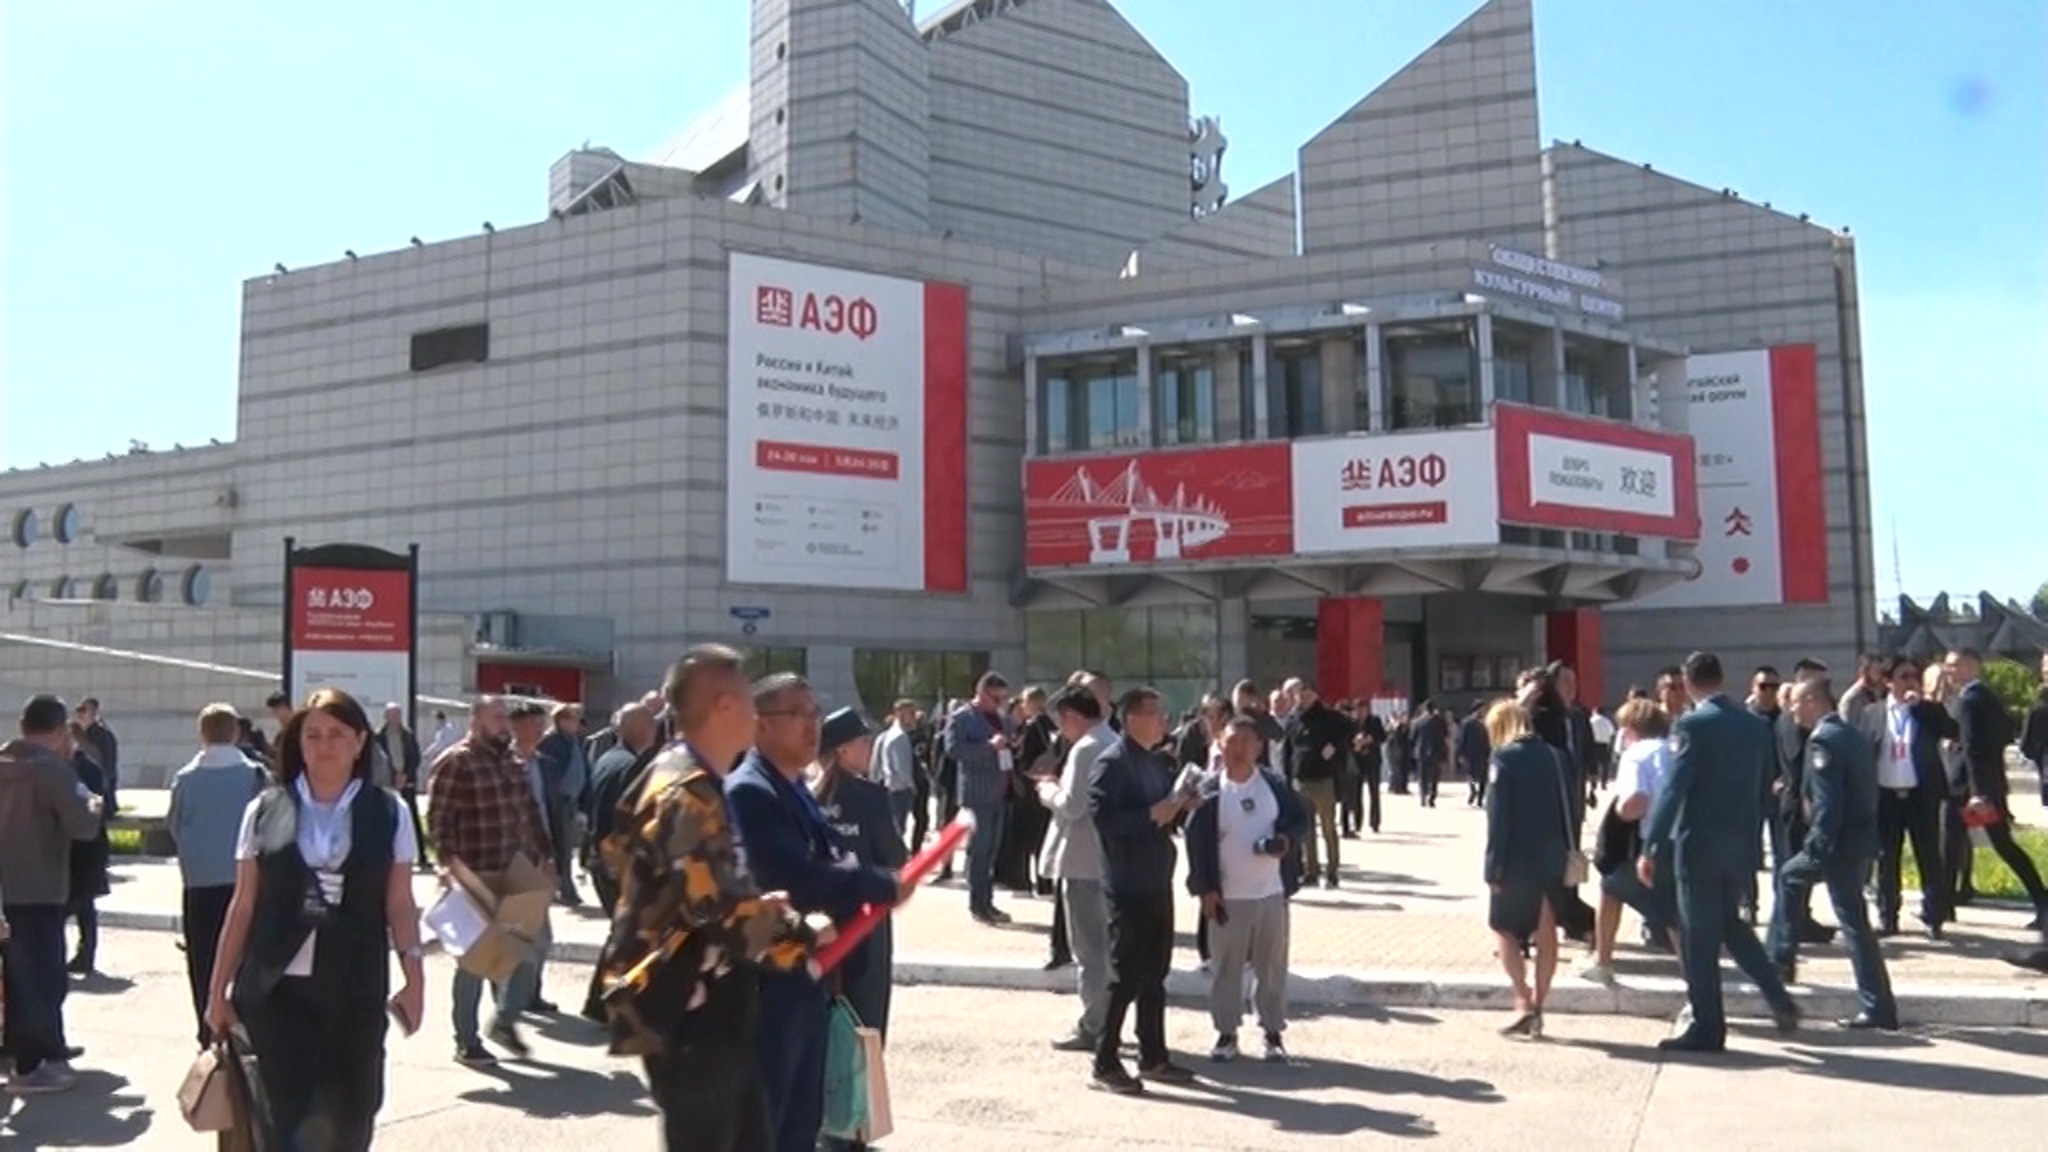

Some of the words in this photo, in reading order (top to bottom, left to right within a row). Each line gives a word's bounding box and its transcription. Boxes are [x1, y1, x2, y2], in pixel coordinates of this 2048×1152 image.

[800, 291, 877, 340] АЭФ
[756, 352, 802, 371] Россия
[805, 362, 813, 373] и
[757, 377, 824, 396] экономика
[828, 383, 888, 403] будущего
[1708, 390, 1747, 403] форум
[1377, 452, 1446, 488] АЭФ
[1562, 456, 1590, 472] ДОБРО
[1620, 465, 1657, 498] 欢迎
[329, 587, 374, 610] АЭФ
